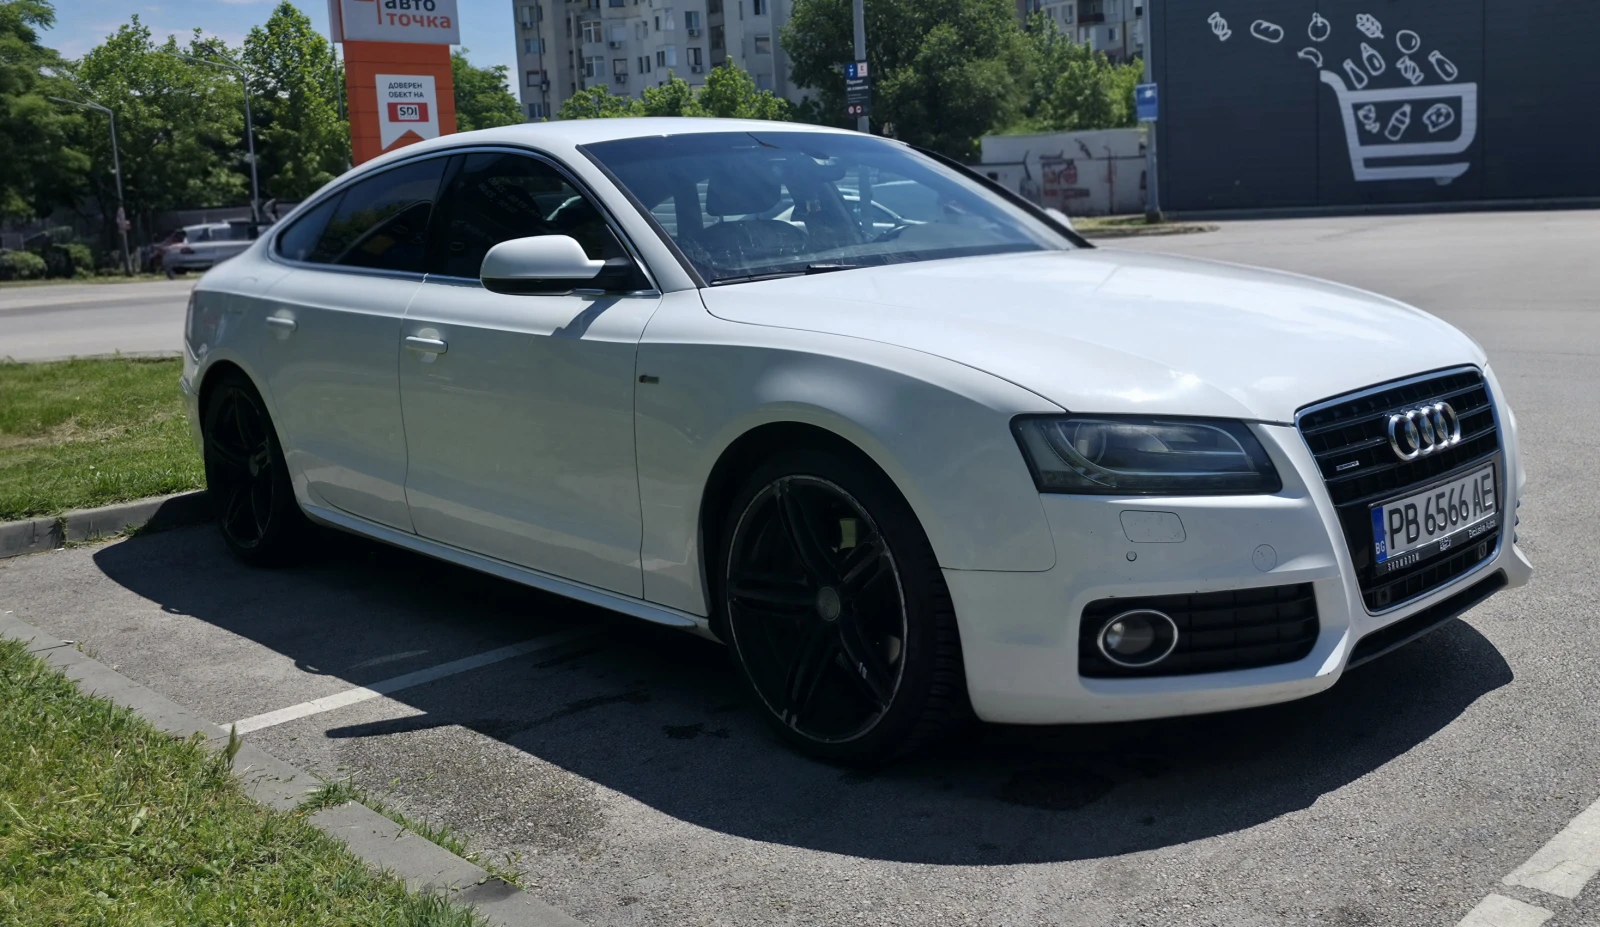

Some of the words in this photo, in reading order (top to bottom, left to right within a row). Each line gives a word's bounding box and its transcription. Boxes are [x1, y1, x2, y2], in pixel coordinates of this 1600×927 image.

[386, 13, 451, 29] точка
[388, 82, 423, 90] ДОВЕРЕН
[399, 106, 418, 116] SDI
[1388, 502, 1420, 550] PB
[1424, 483, 1470, 536] 6566
[1473, 472, 1493, 517] AE
[1375, 540, 1386, 555] BG
